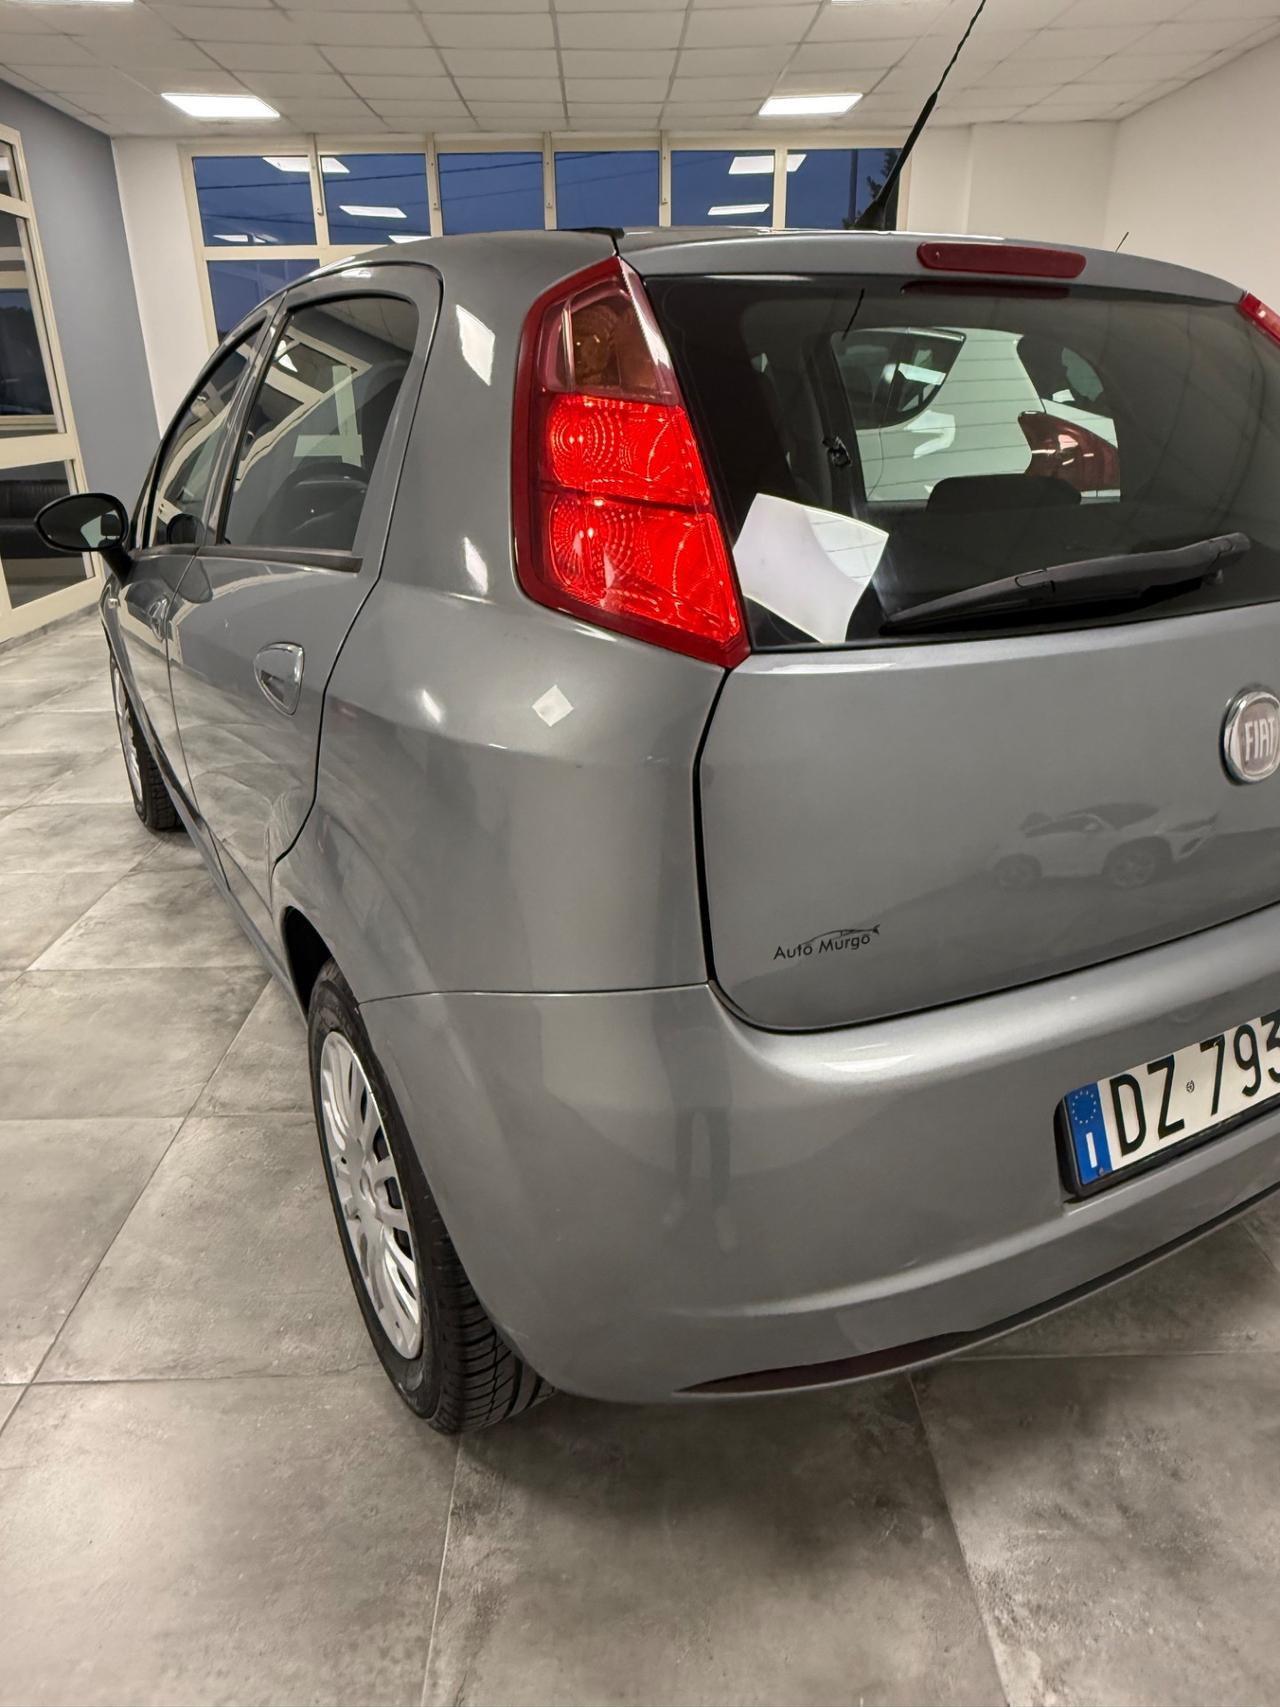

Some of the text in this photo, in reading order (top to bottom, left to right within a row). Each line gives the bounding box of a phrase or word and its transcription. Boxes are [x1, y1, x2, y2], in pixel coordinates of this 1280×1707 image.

[1244, 717, 1275, 762] FIAT
[773, 934, 872, 960] Auto Murgo
[1109, 1054, 1186, 1158] DZ
[1199, 1008, 1280, 1118] 793
